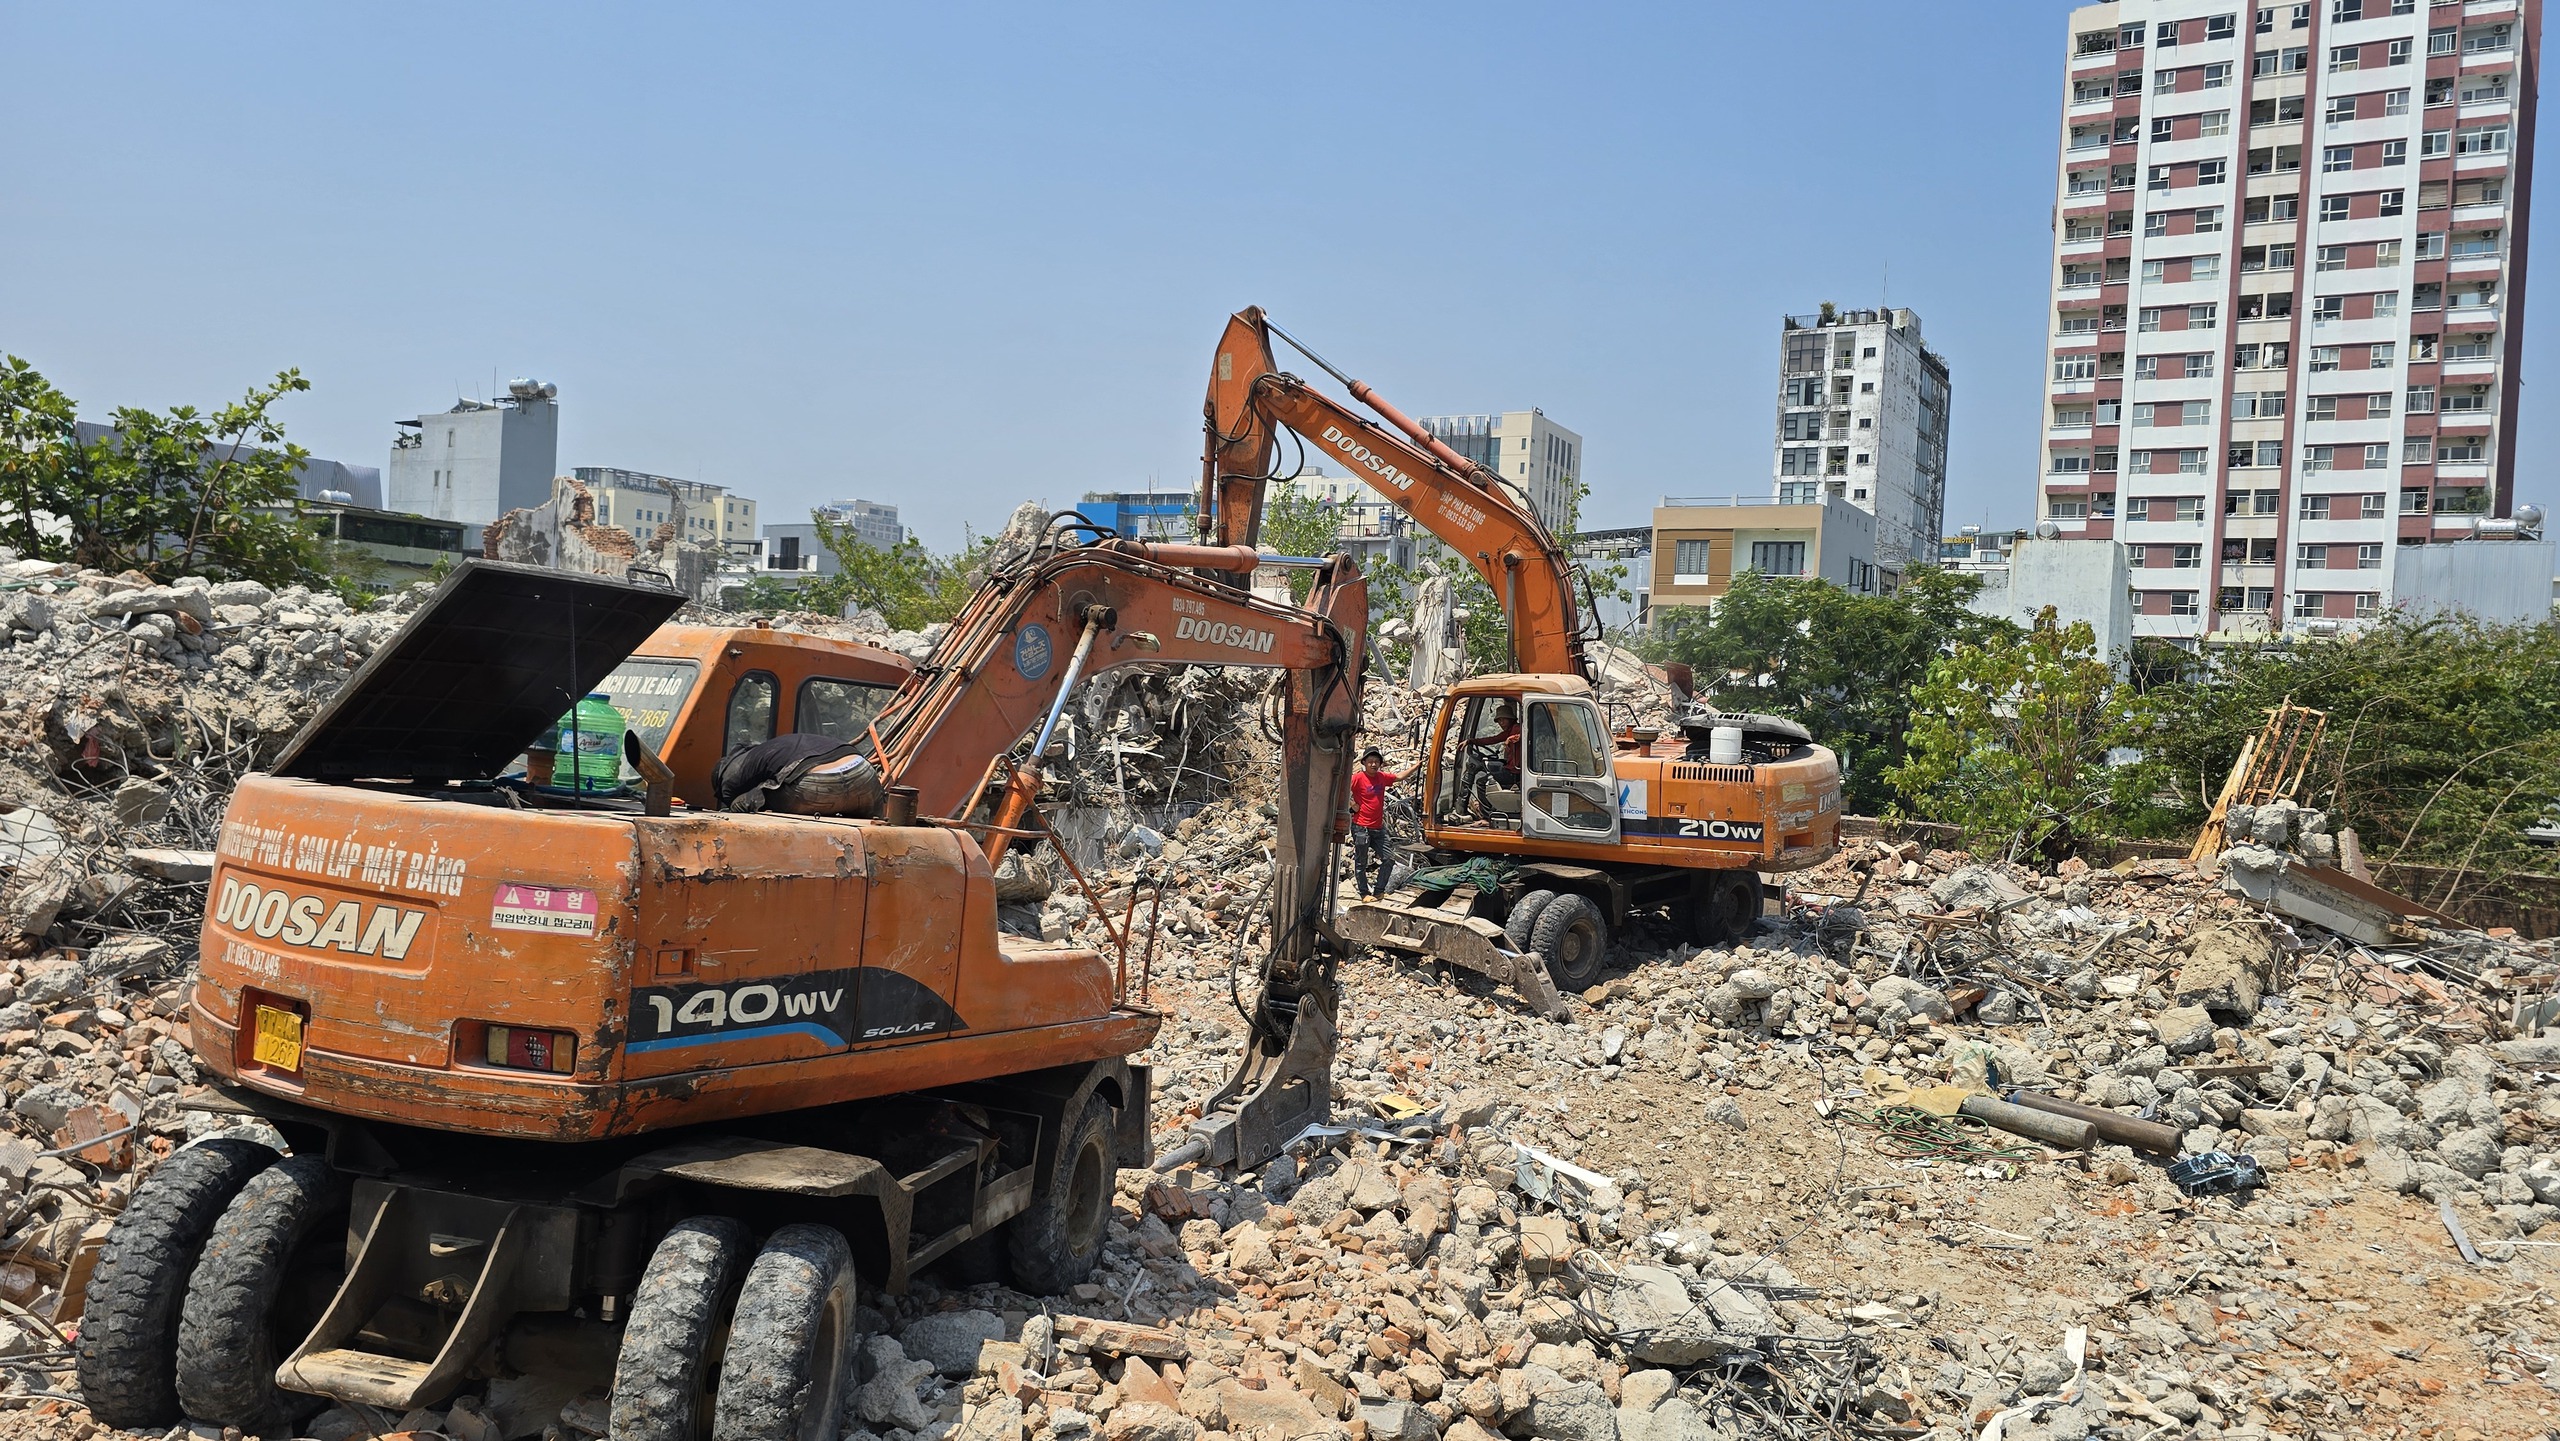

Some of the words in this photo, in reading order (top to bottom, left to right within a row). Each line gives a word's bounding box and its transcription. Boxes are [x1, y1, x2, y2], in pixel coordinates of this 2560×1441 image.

[1321, 425, 1415, 491] DOOSAN
[1175, 616, 1275, 653] DOOSAN
[637, 676, 659, 695] XE
[282, 832, 296, 869] &
[295, 834, 329, 874] SAN
[361, 840, 407, 892] MẶT
[405, 840, 467, 897] BẰNG
[215, 877, 426, 960] DOOSAN
[862, 1021, 936, 1038] SOLAR
